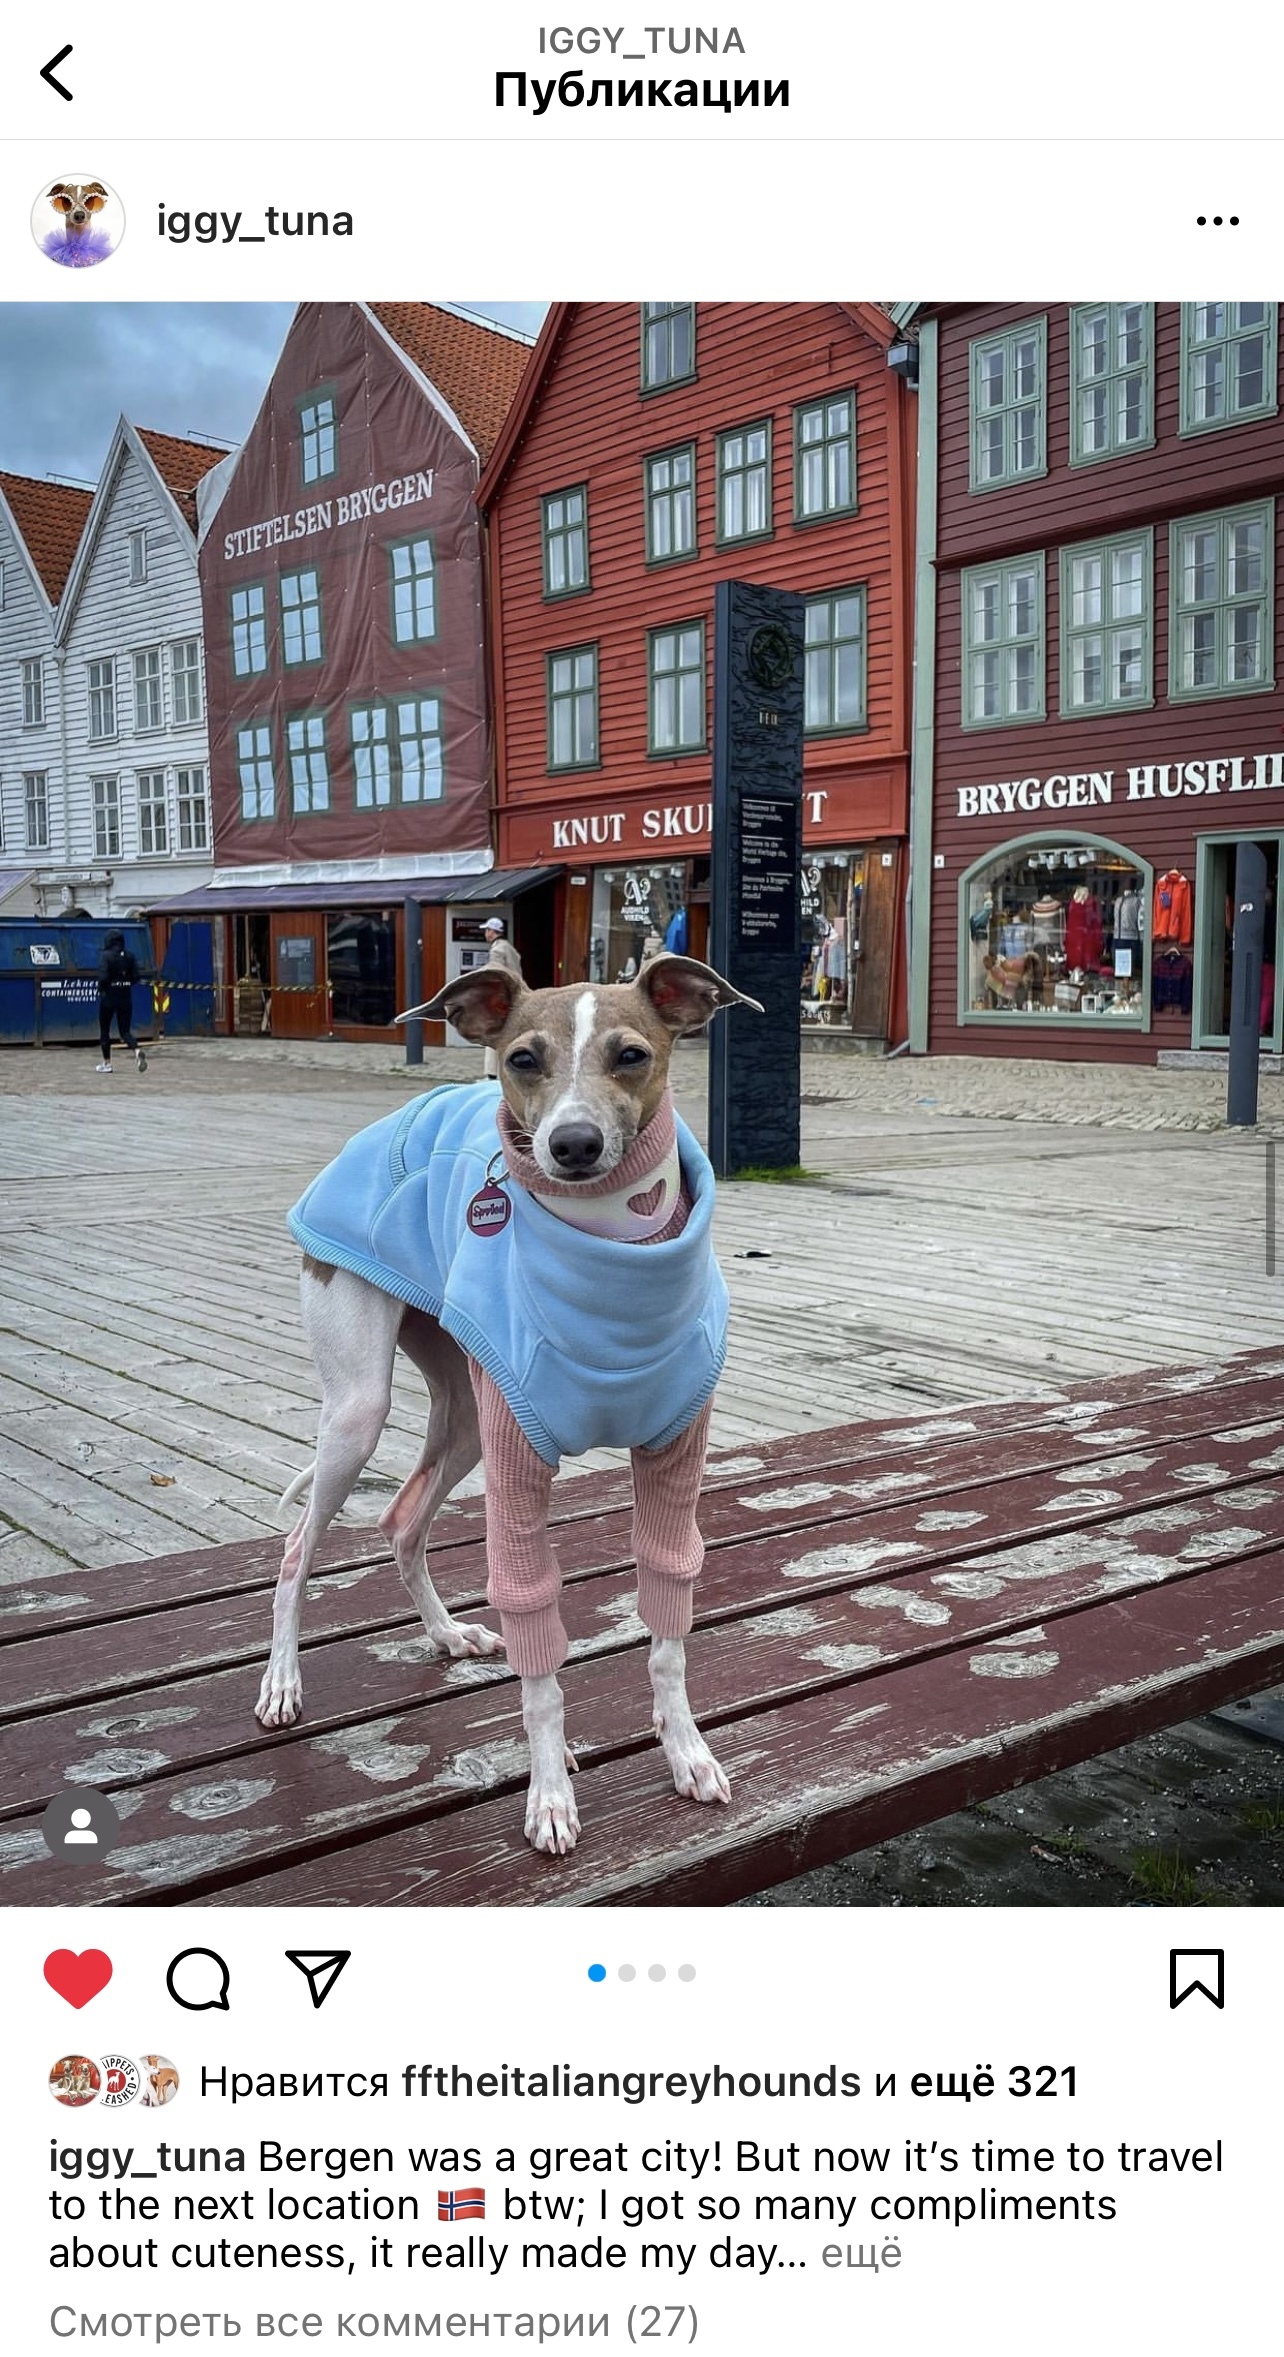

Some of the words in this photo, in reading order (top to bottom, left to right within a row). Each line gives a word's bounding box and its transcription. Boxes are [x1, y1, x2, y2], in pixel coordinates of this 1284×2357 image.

[223, 500, 333, 560] STIFTELSEN
[336, 468, 435, 526] BRYGGEN
[956, 770, 1115, 818] BRYGGEN
[552, 813, 626, 849] KNUT
[41, 989, 100, 998] CONTAINERSERV
